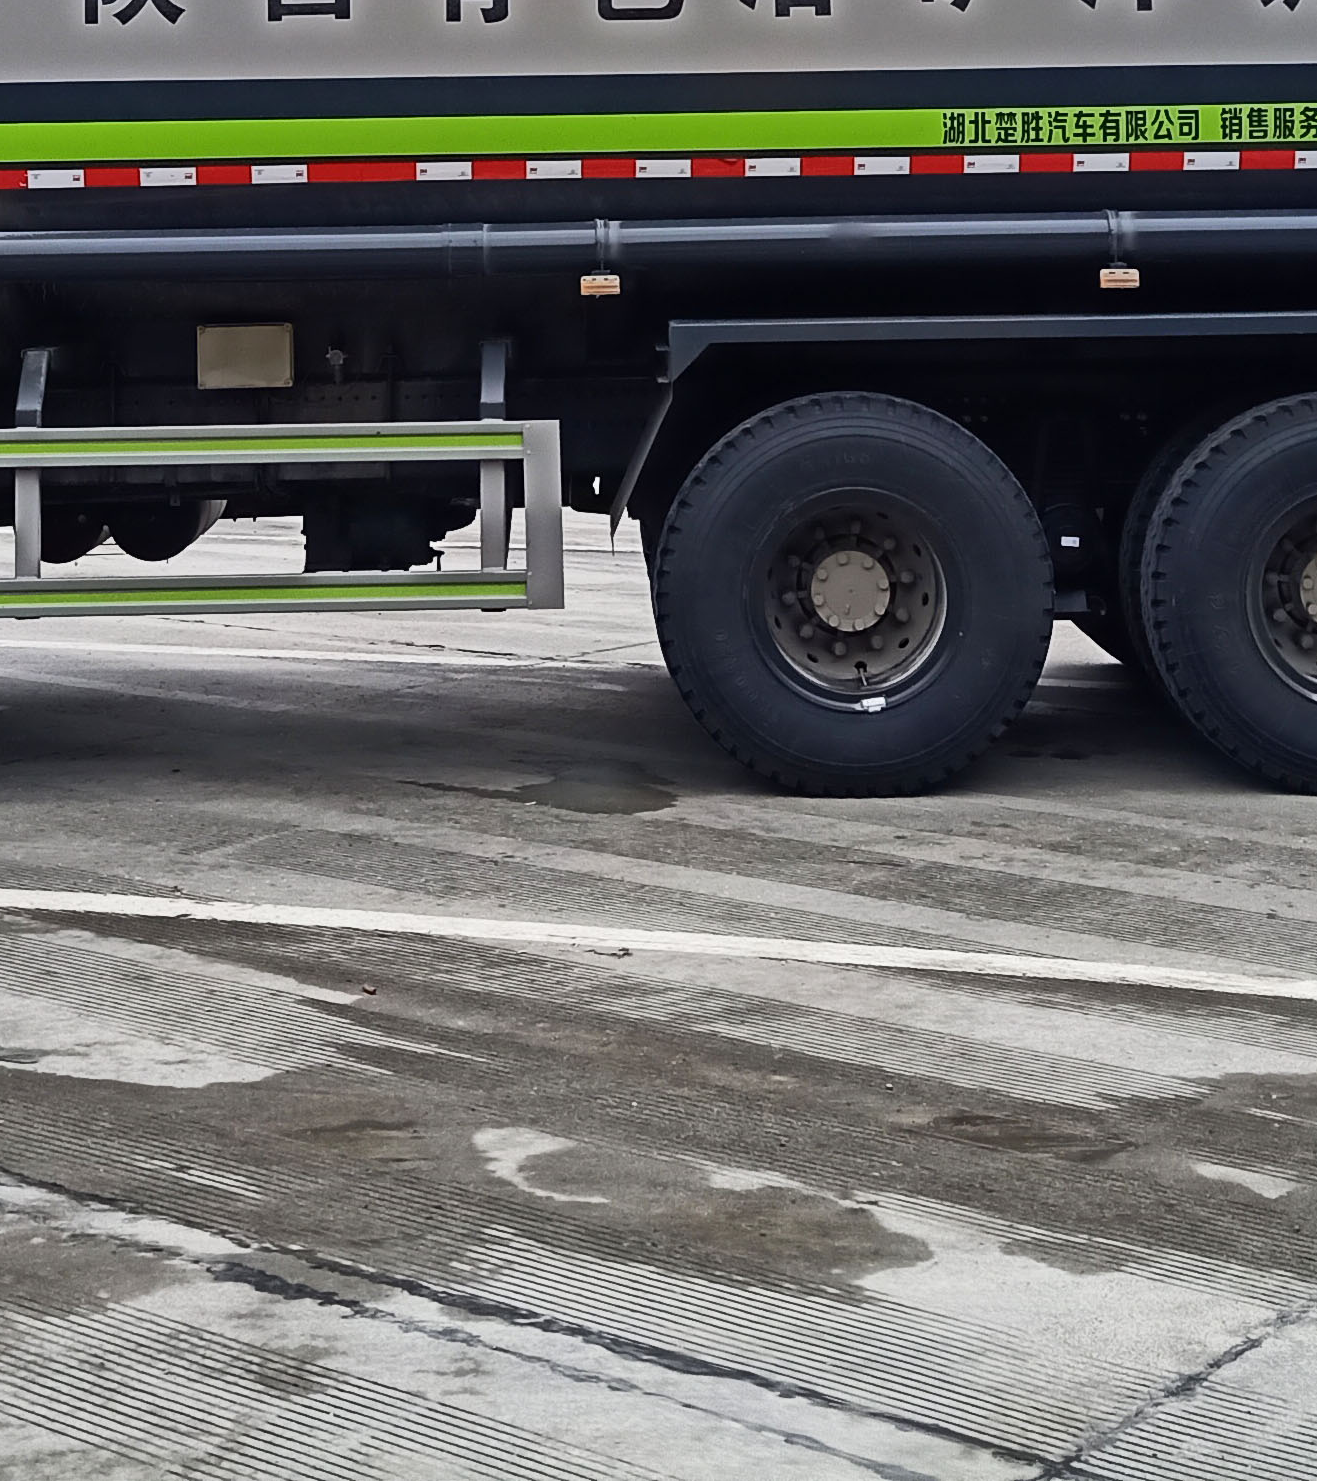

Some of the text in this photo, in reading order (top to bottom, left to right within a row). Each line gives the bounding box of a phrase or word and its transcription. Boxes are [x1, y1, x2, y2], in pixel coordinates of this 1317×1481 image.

[941, 108, 1201, 145] 湖北楚胜汽车有限公司
